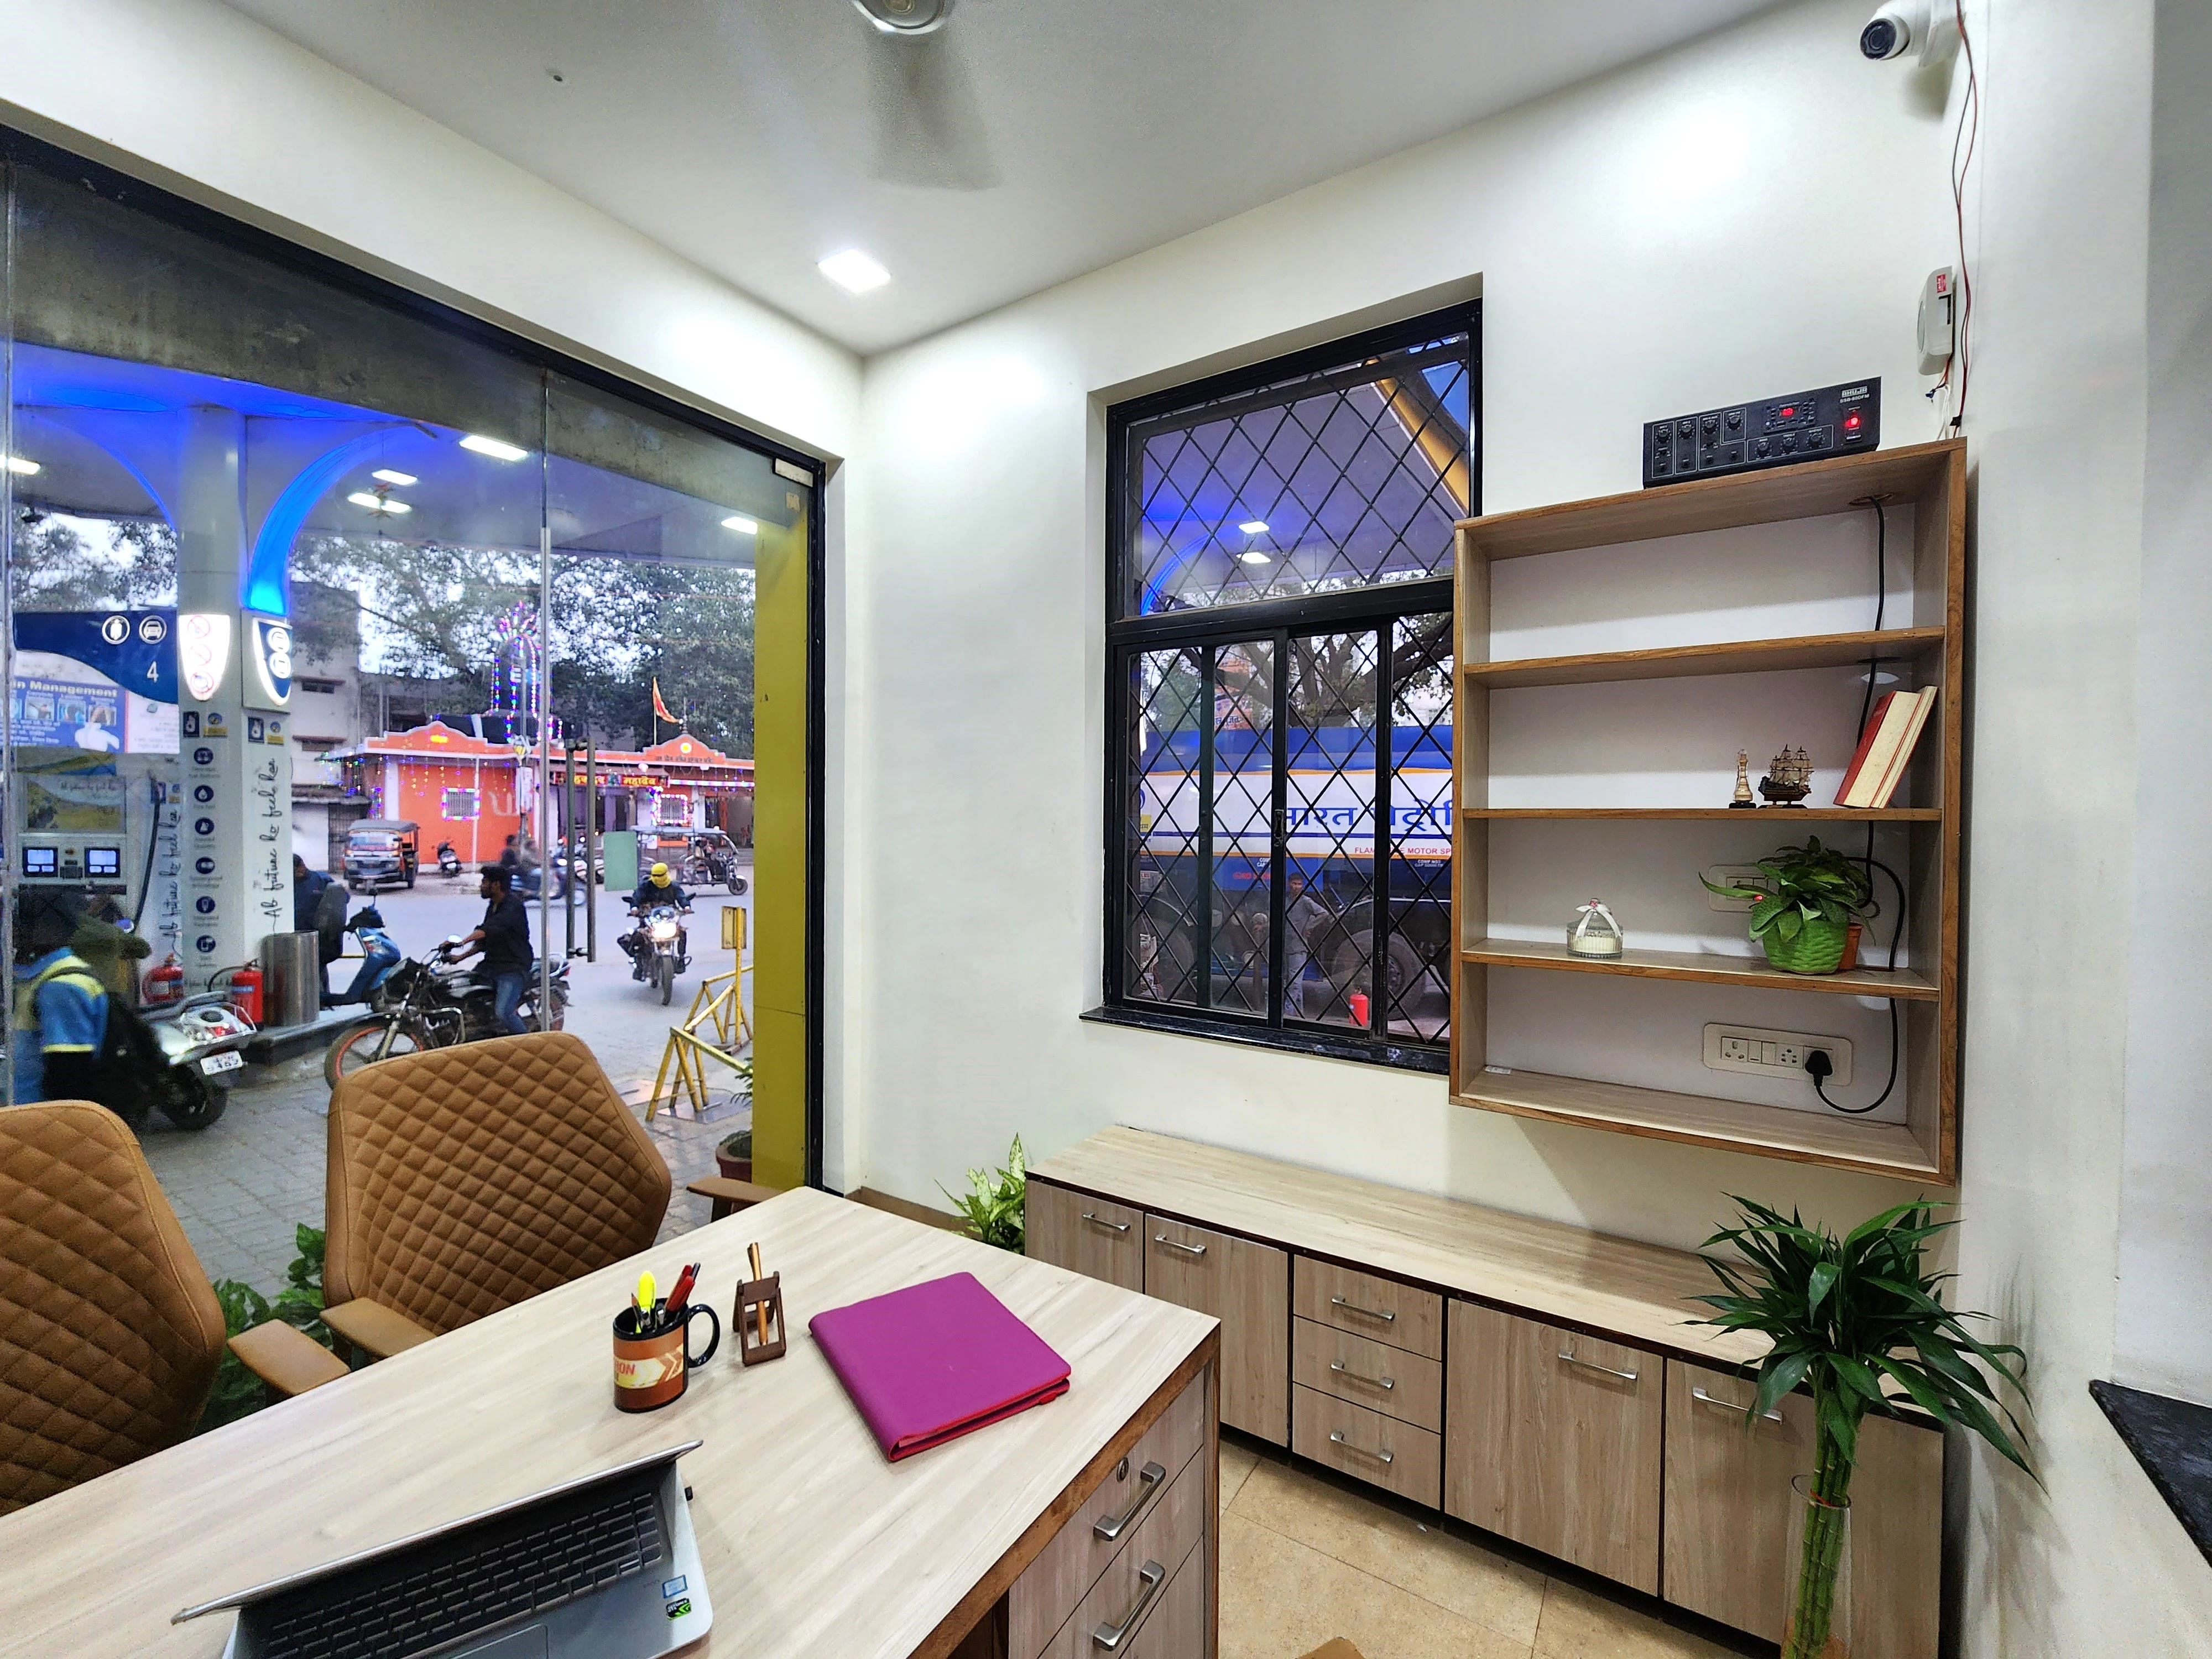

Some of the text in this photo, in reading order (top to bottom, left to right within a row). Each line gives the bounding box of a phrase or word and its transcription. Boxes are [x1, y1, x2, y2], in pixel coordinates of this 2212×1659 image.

[1841, 386, 1867, 398] AHUJA
[147, 661, 159, 684] 4
[30, 681, 118, 698] Management
[257, 786, 283, 818] feel
[263, 848, 284, 892] future
[260, 898, 283, 919] Ab
